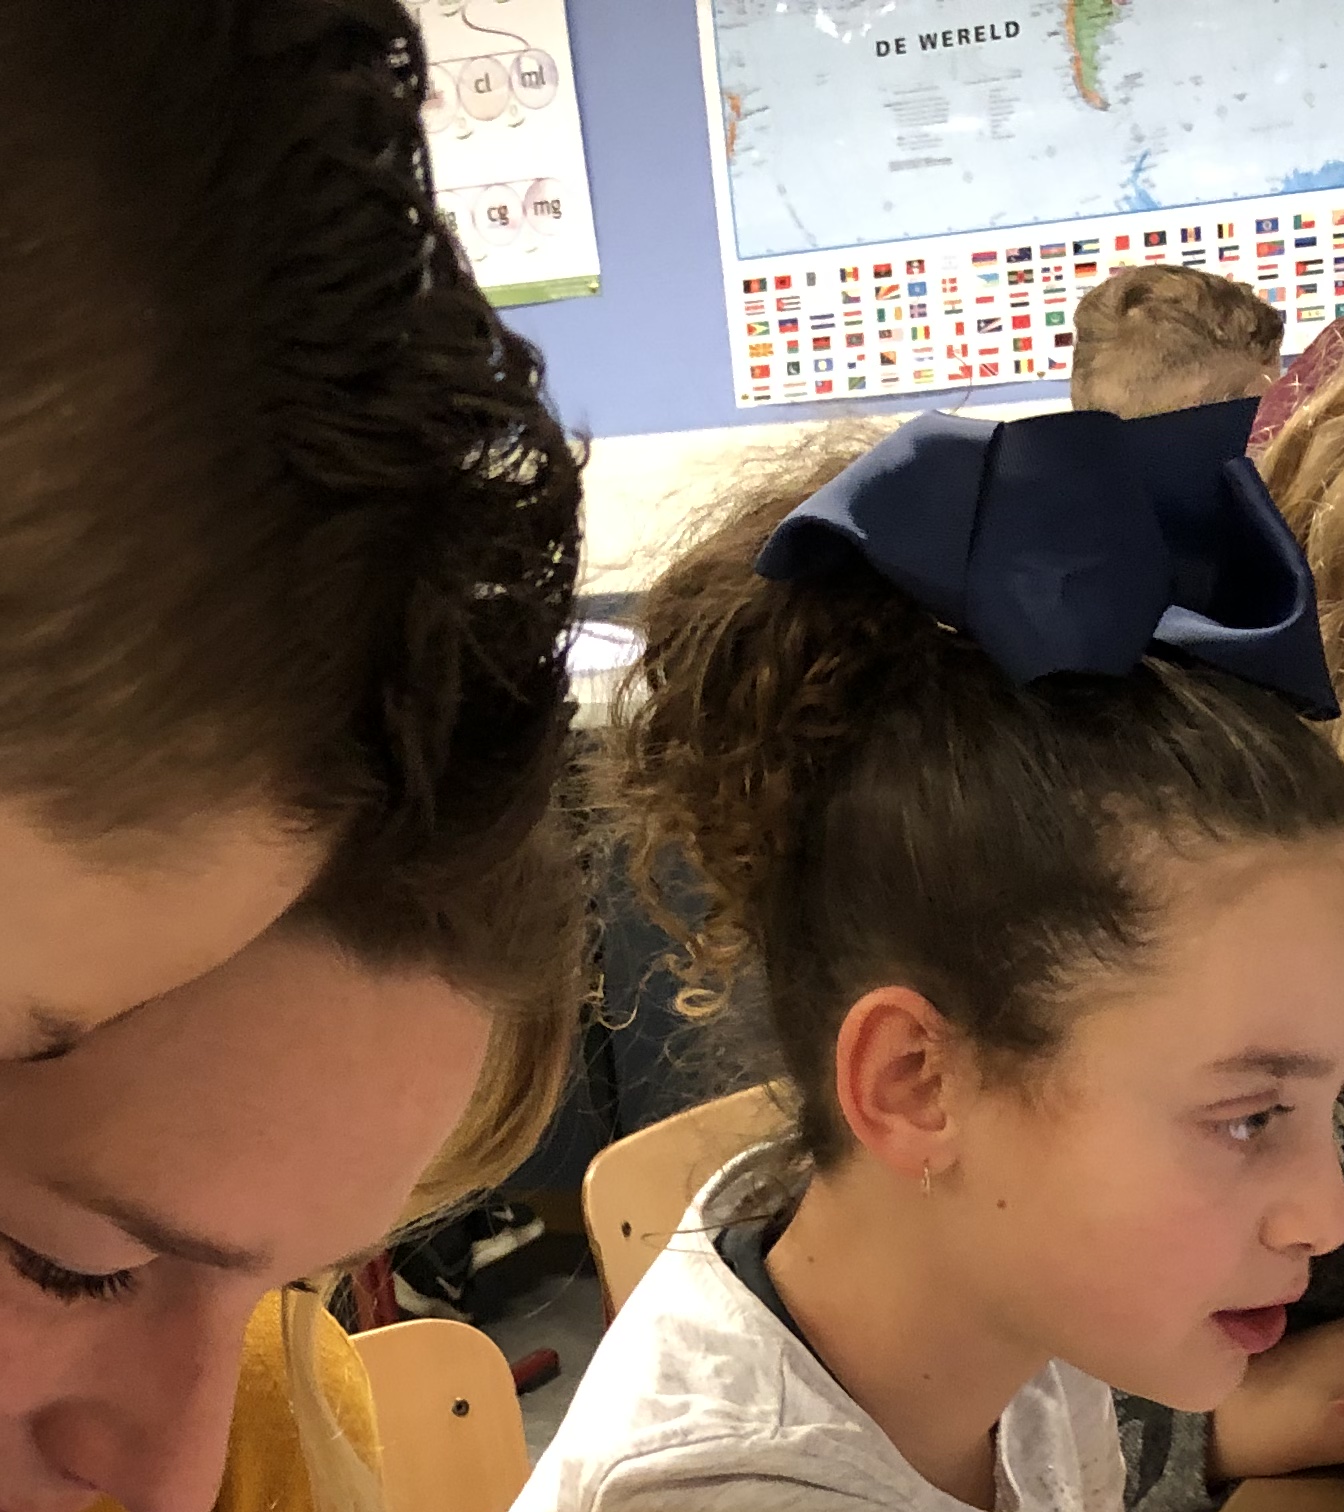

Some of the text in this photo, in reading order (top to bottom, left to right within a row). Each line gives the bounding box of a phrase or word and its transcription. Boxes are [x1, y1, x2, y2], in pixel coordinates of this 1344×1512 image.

[875, 21, 1020, 57] DE WERELD
[474, 64, 546, 94] cl ml
[487, 199, 562, 226] cg mg
